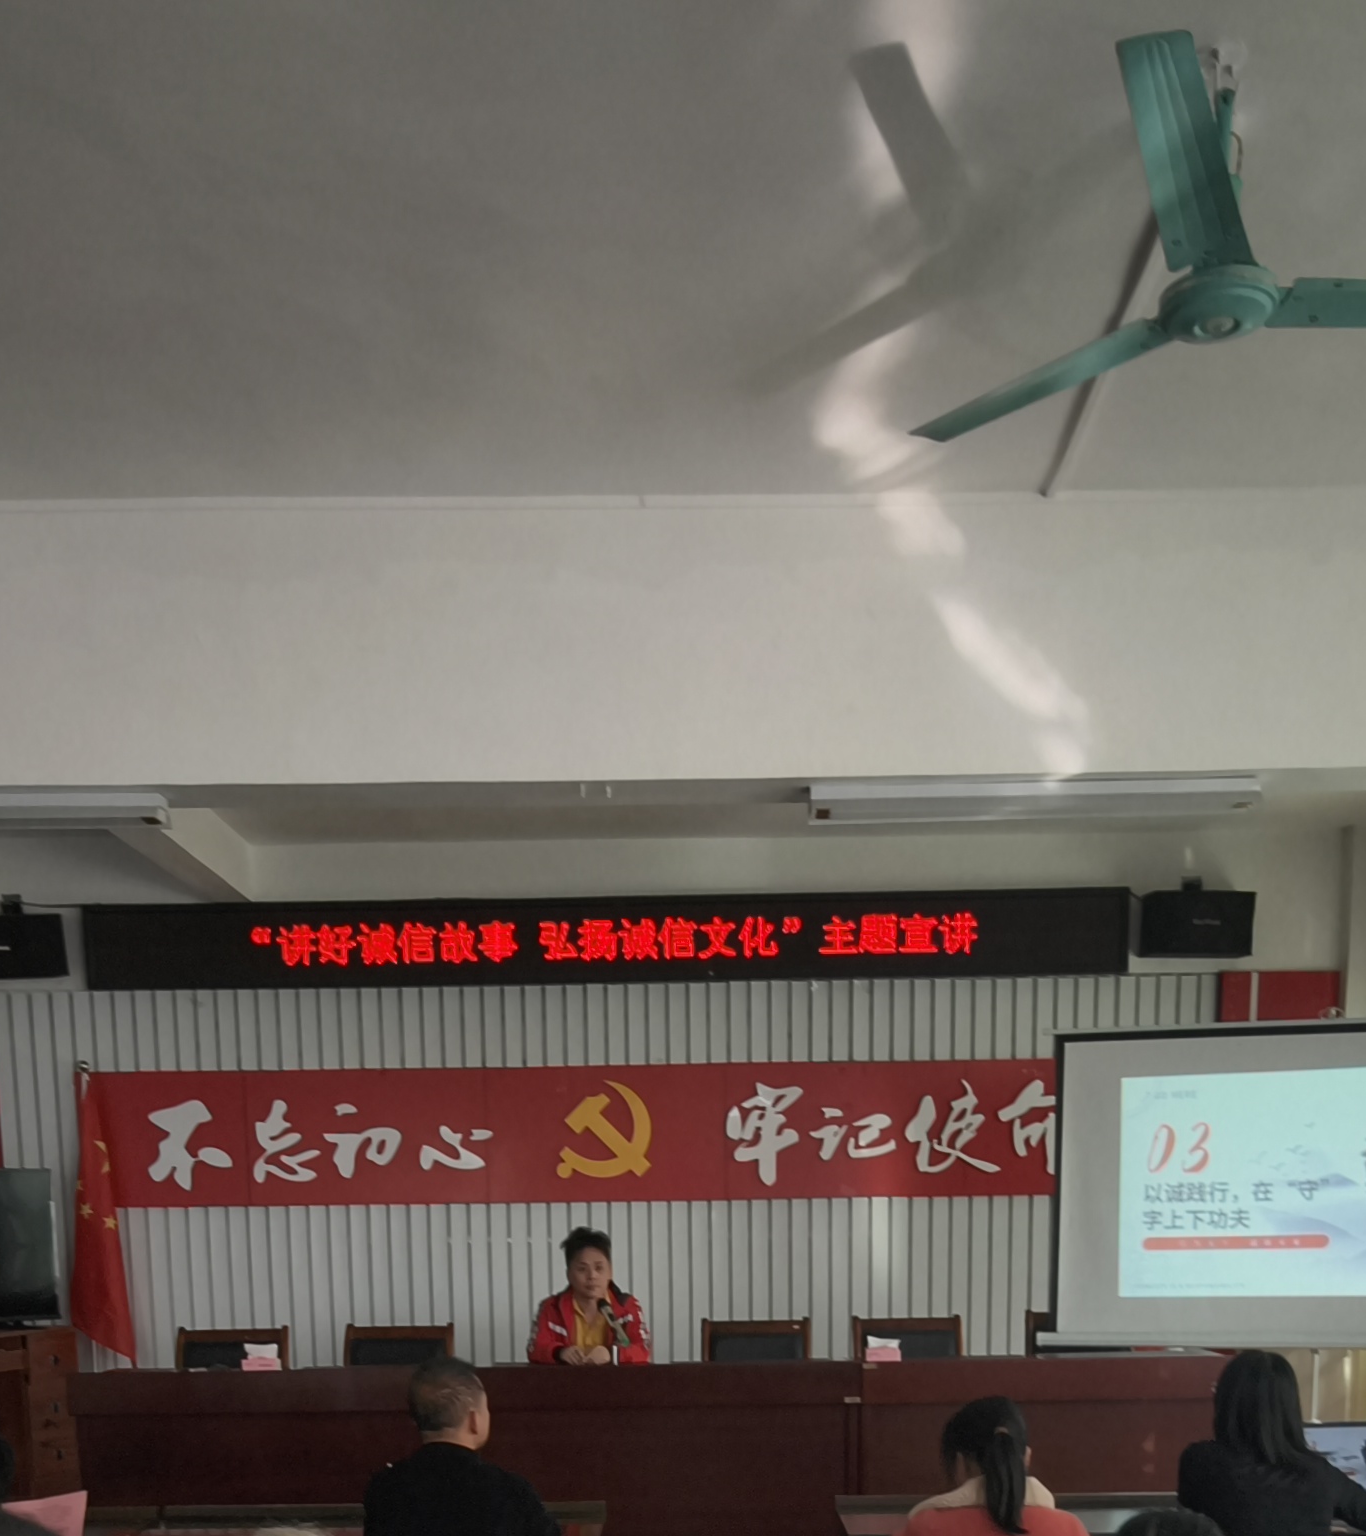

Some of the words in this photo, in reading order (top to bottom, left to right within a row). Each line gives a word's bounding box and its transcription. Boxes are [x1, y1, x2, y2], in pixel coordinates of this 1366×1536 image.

[819, 912, 978, 956] 主题宣讲
[147, 1099, 494, 1191] 不忘初心
[1147, 1122, 1211, 1174] 03
[1142, 1209, 1250, 1230] 字上下功夫
